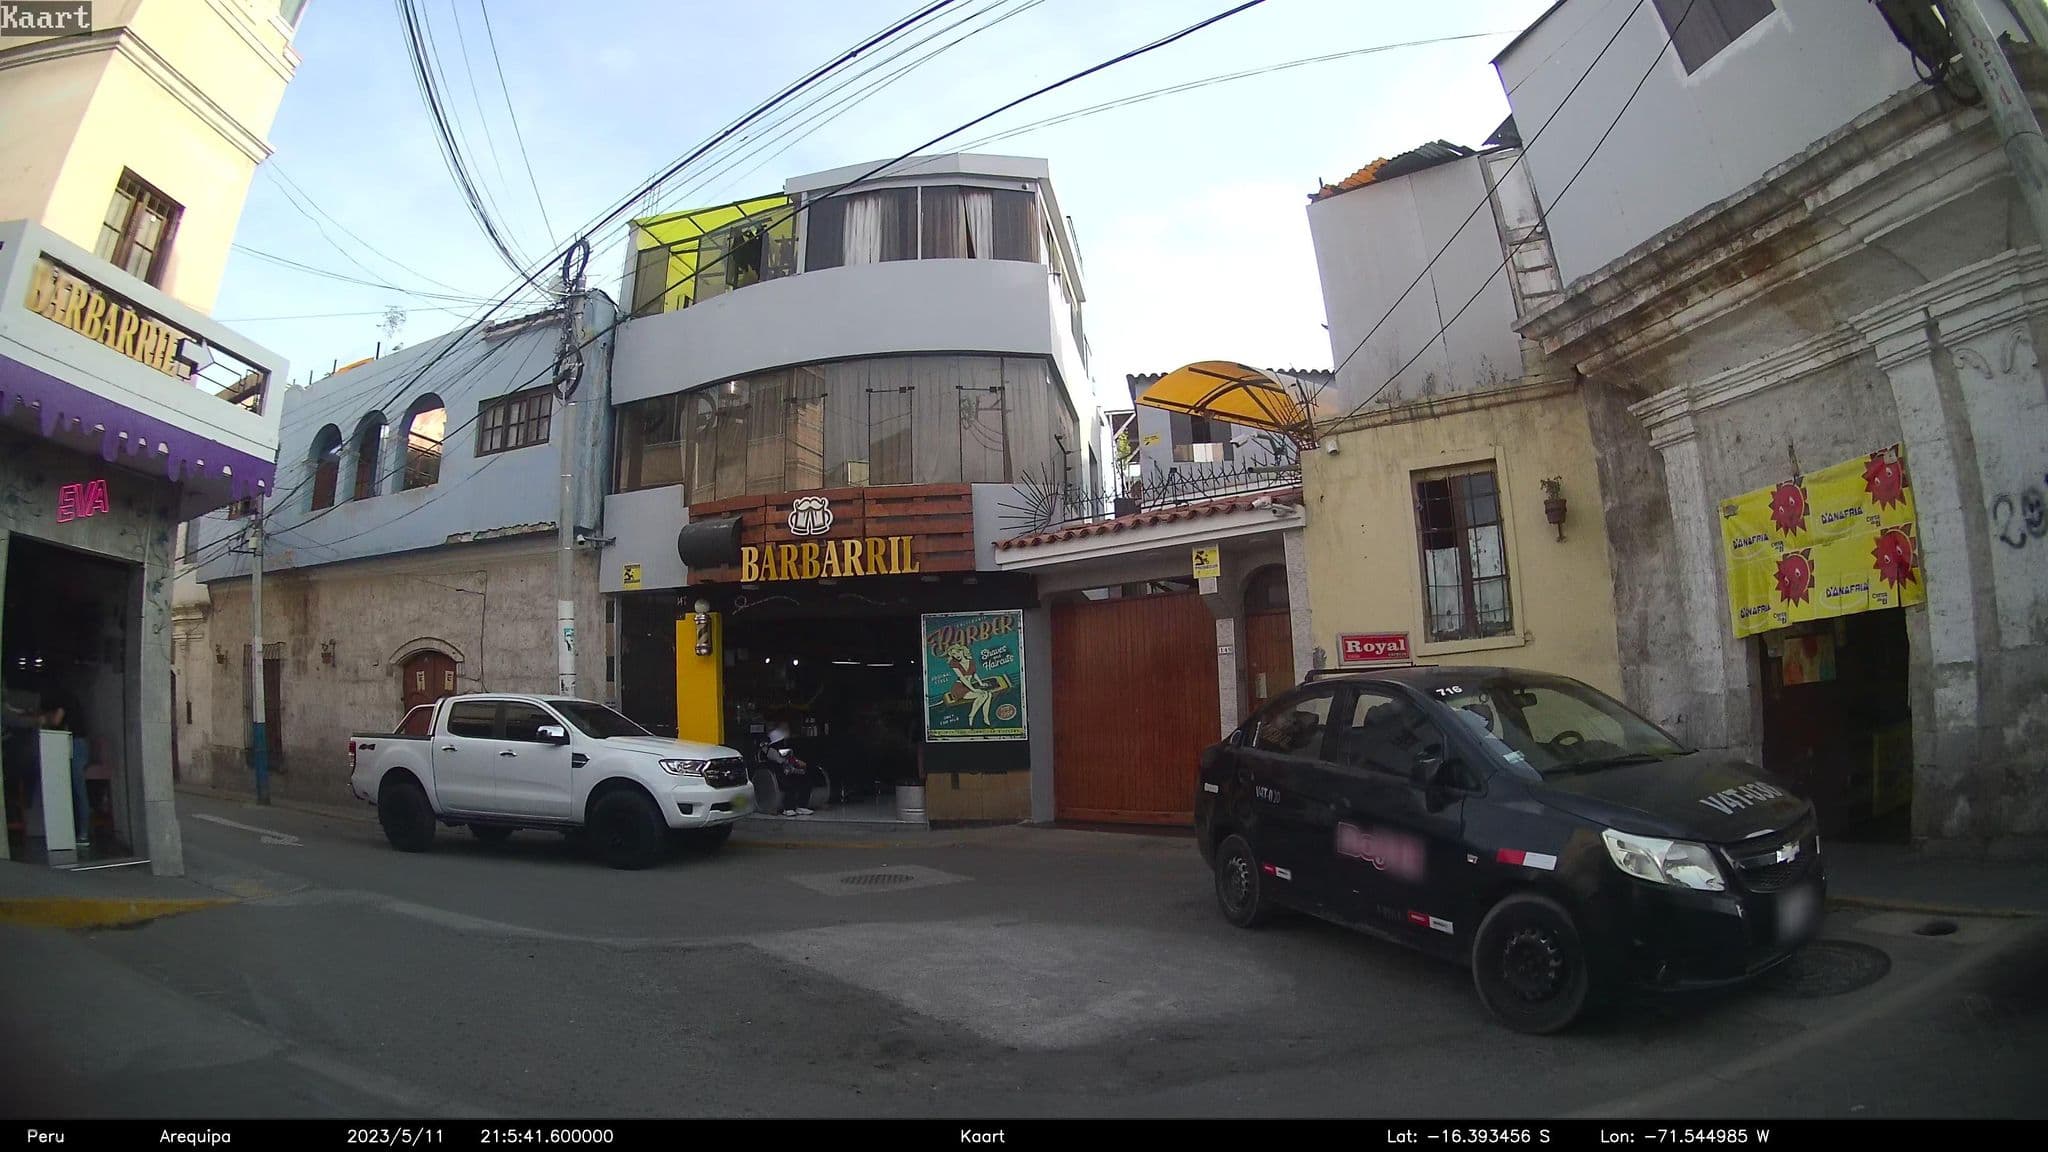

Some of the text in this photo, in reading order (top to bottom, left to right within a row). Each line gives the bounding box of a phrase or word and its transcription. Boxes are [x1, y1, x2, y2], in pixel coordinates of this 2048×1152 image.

[57, 479, 110, 523] EVA
[740, 535, 920, 583] BARBARRIL
[1345, 639, 1406, 655] Royal
[1435, 685, 1463, 696] 716
